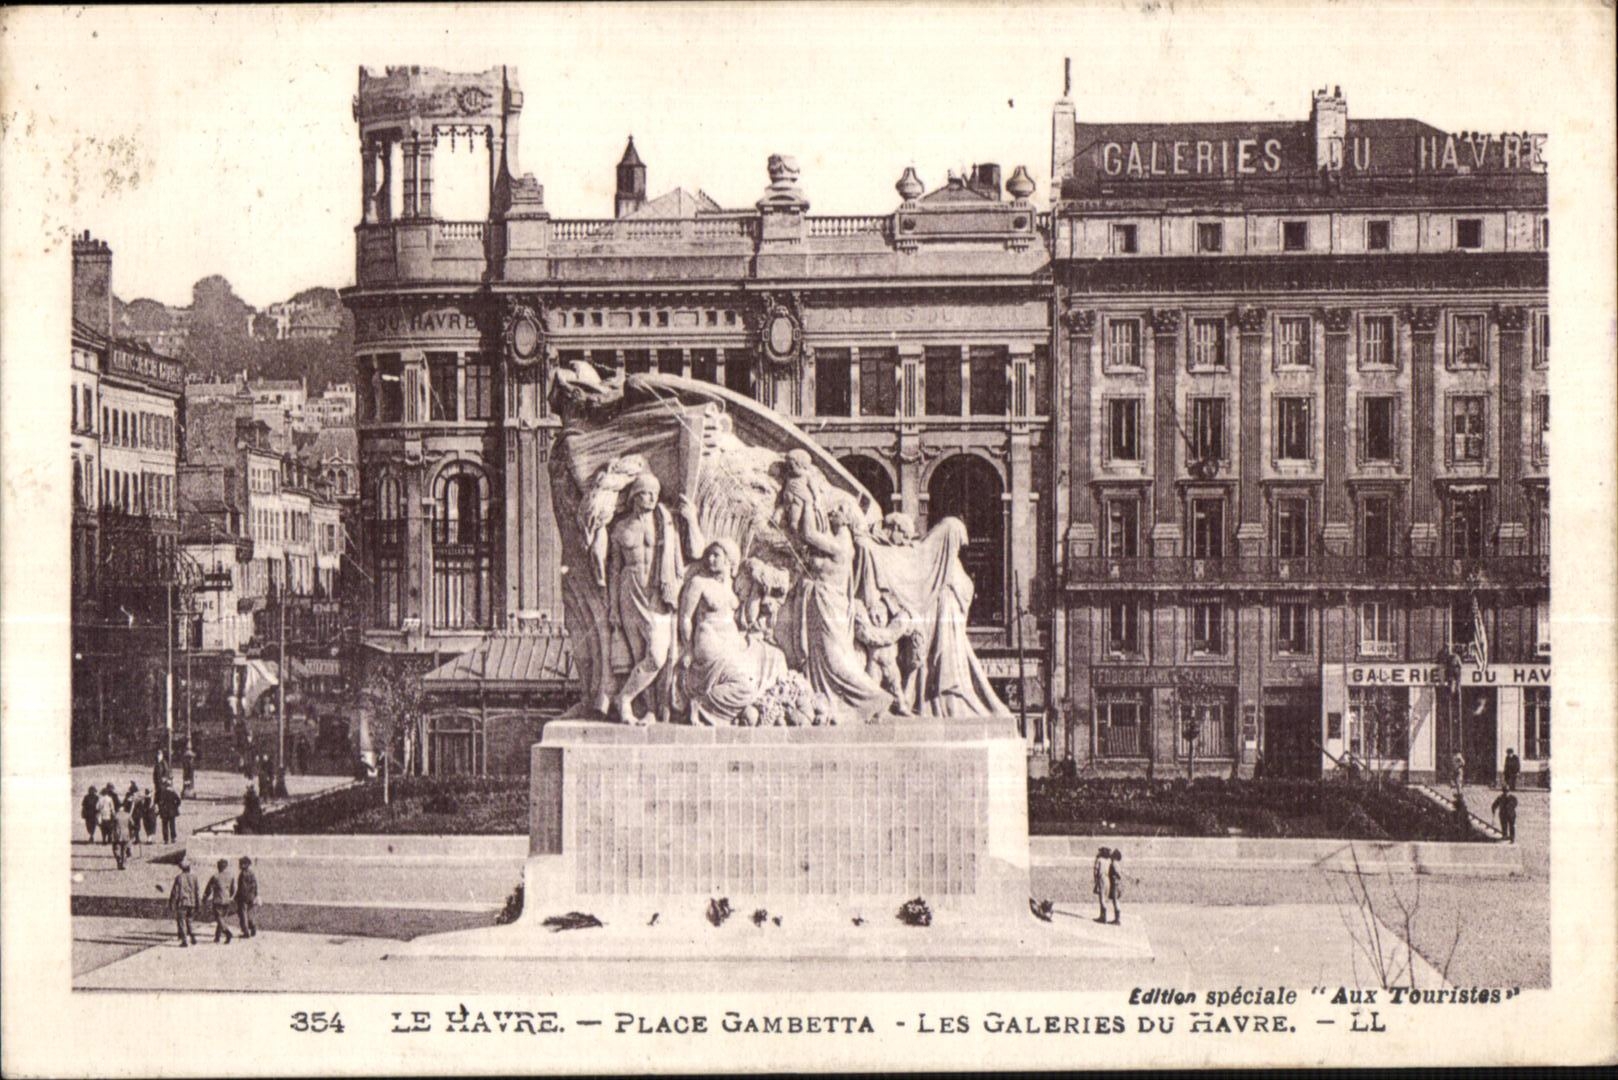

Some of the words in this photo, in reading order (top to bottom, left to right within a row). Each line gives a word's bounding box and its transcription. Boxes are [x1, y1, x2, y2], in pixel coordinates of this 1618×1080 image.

[1102, 138, 1283, 176] GALERIES
[1326, 136, 1371, 172] DU
[1418, 133, 1548, 174] HAVRE
[1352, 668, 1452, 683] GALERIE
[1472, 670, 1497, 683] DU
